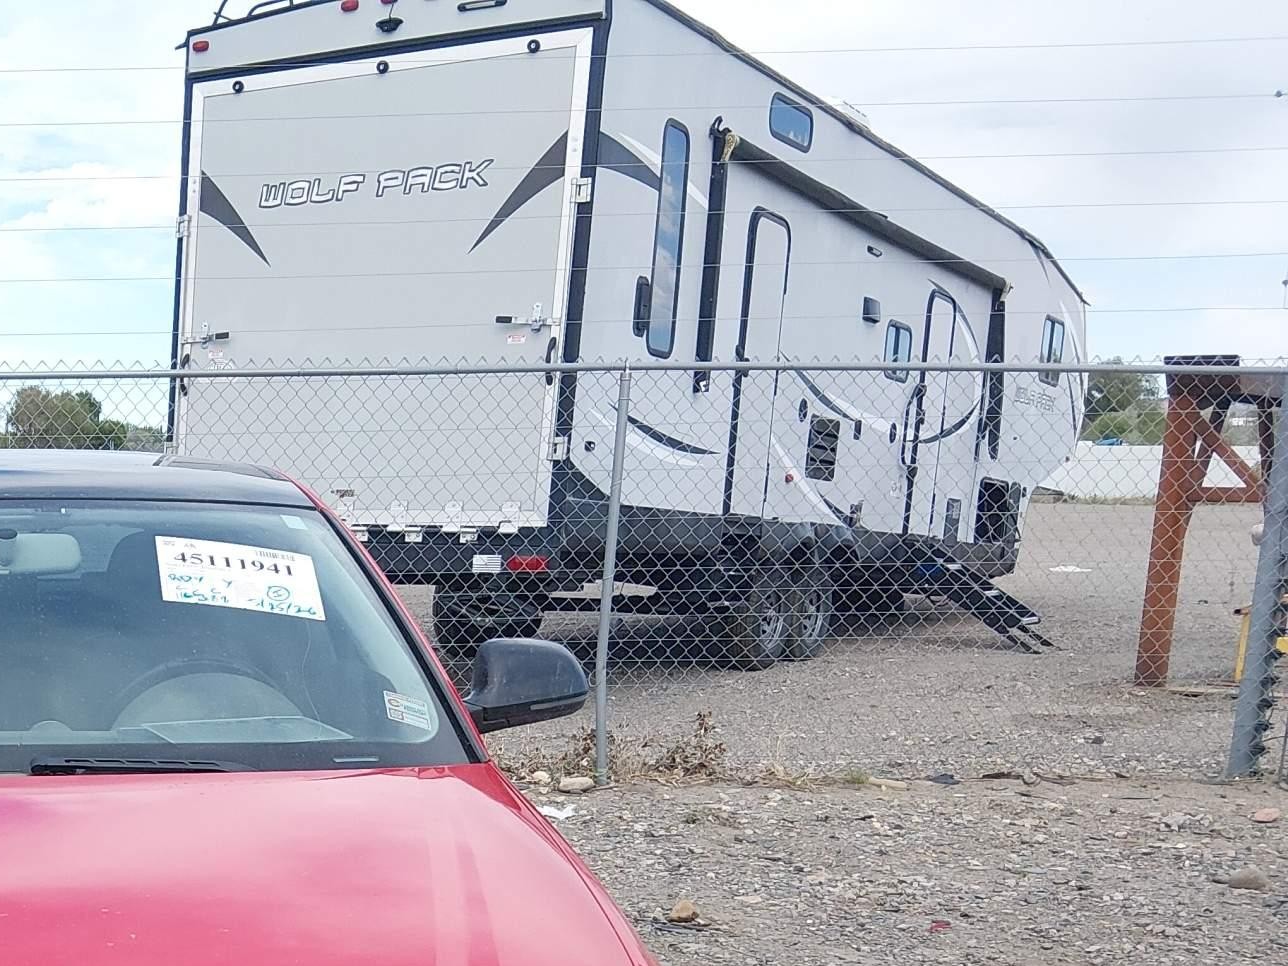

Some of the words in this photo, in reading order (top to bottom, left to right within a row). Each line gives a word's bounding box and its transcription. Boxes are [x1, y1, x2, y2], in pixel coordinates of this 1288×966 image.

[258, 174, 366, 208] WOLF
[376, 158, 495, 198] PACK
[173, 552, 294, 577] 45111941
